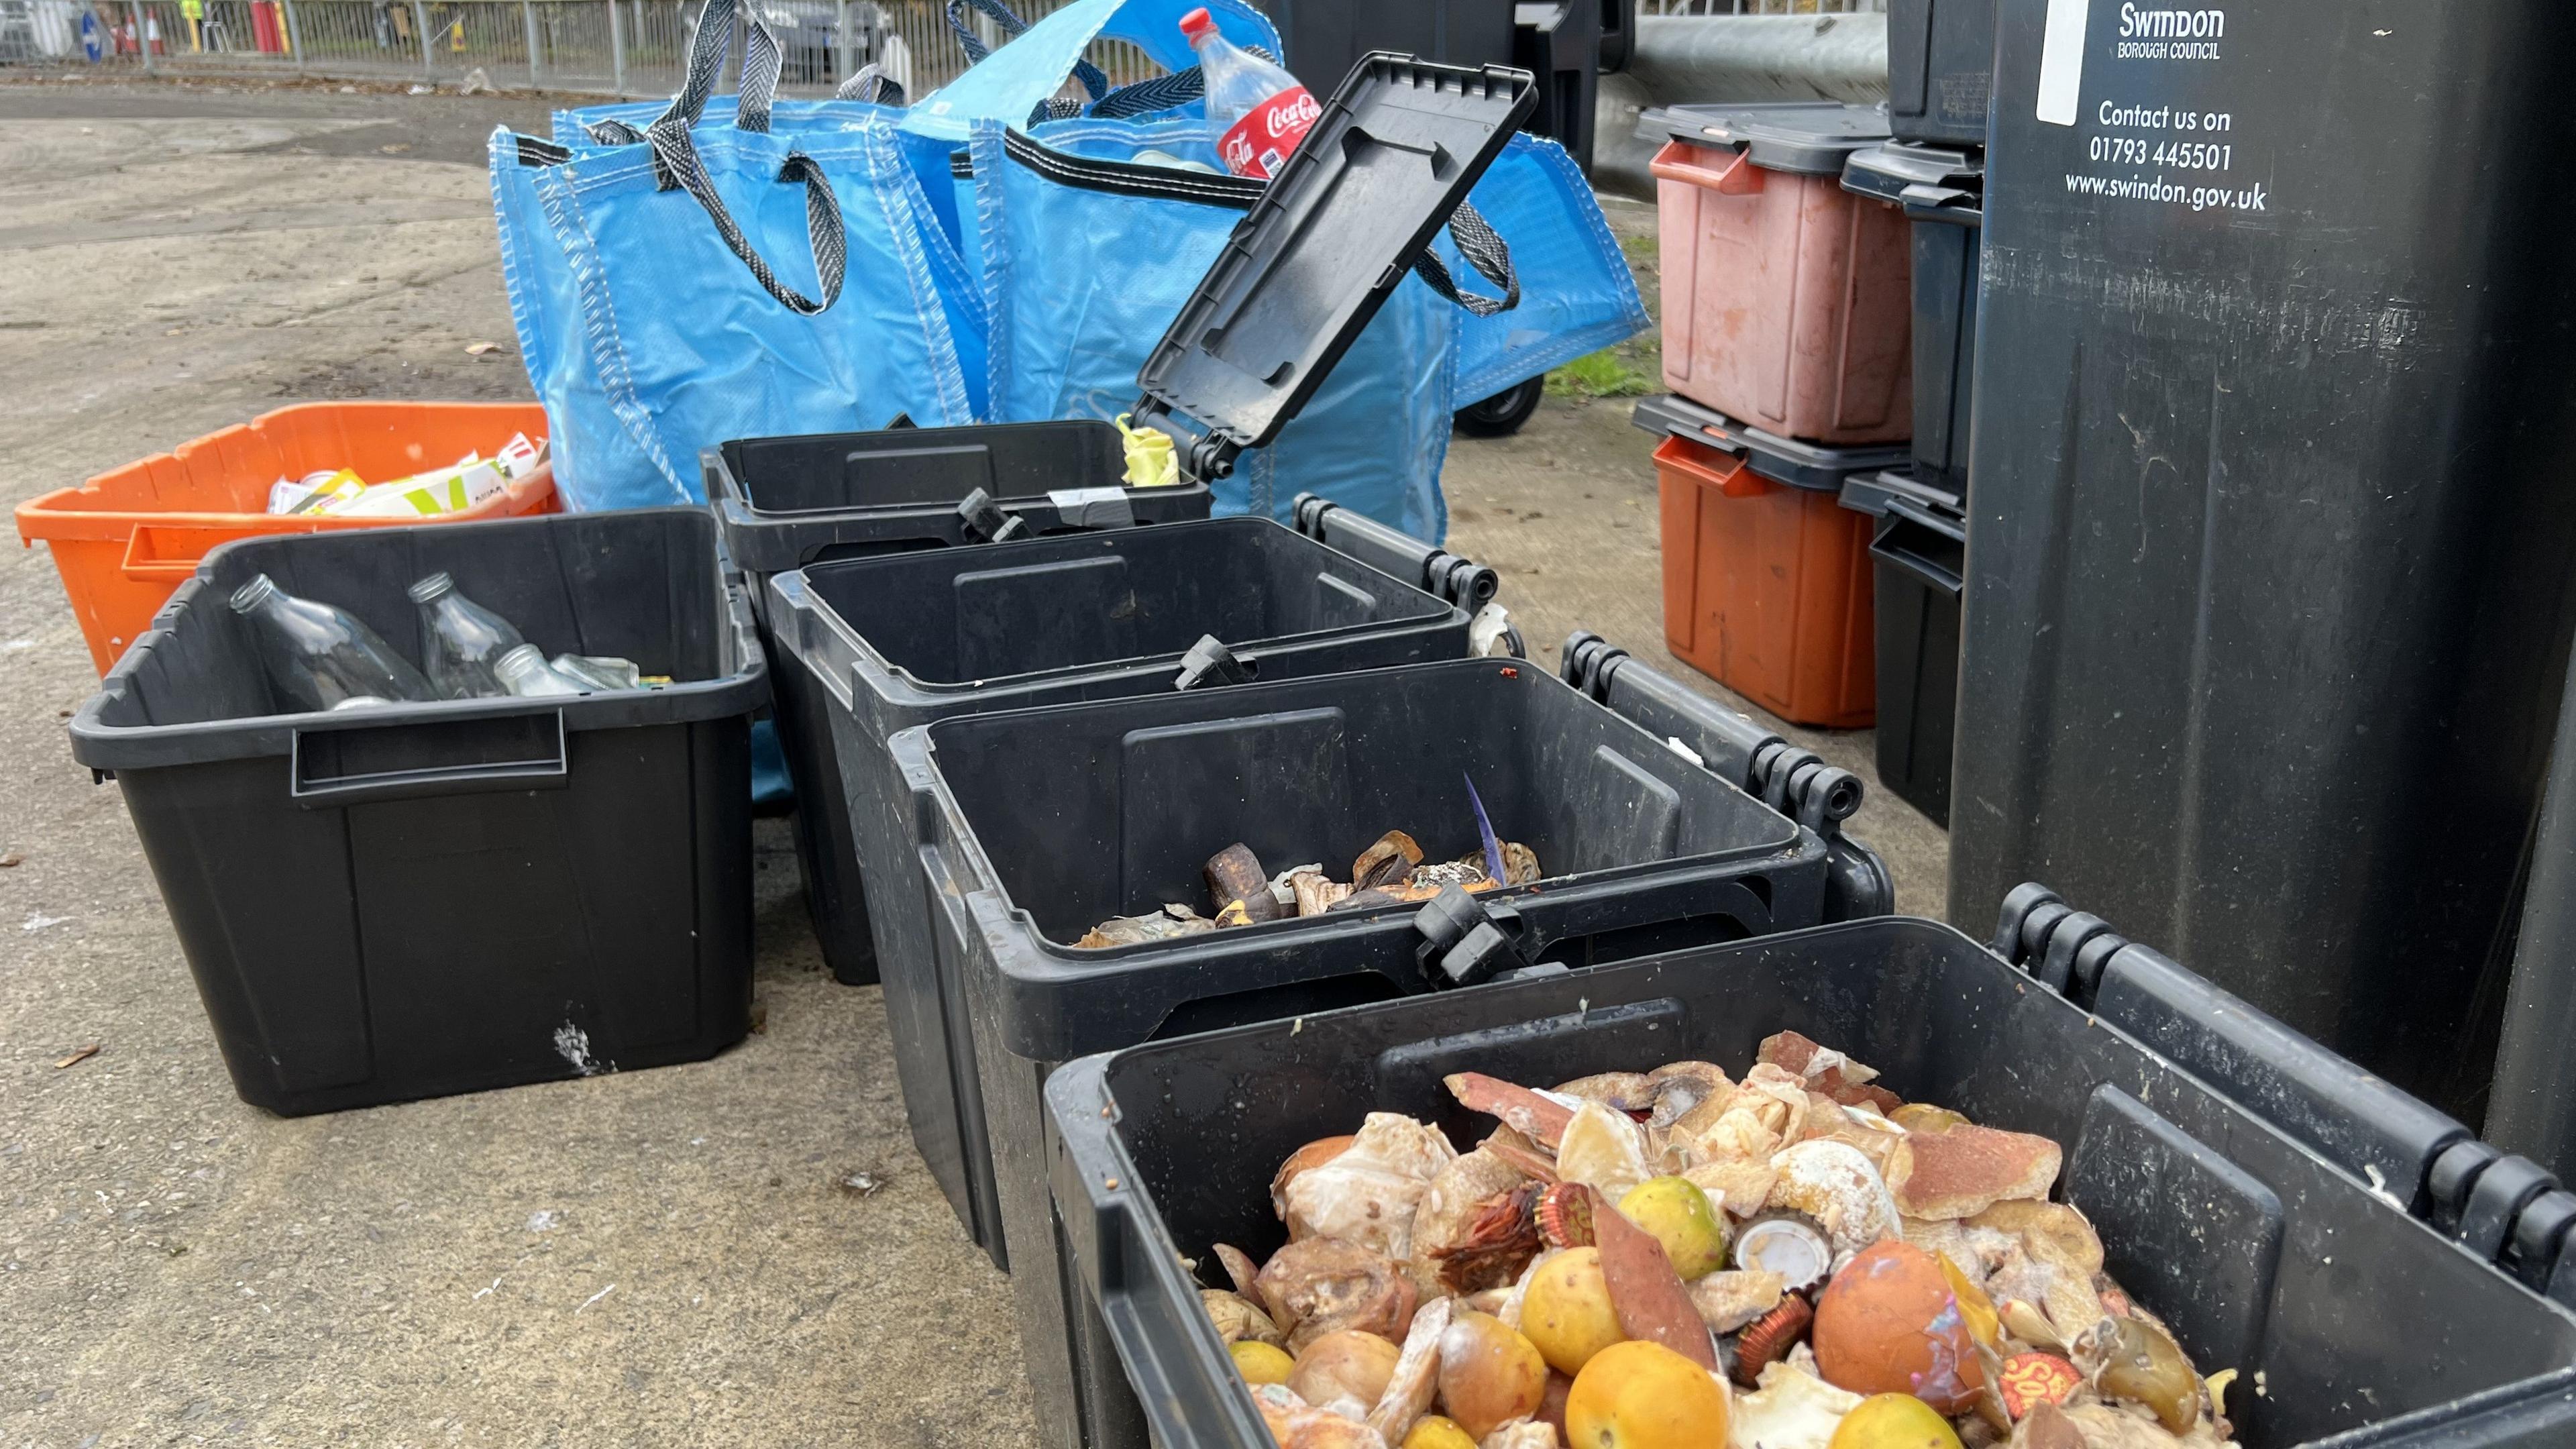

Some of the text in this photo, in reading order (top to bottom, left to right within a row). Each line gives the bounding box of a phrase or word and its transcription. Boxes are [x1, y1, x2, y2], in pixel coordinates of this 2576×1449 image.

[2117, 42, 2220, 60] BOROUGH COUNCIL
[2098, 100, 2231, 131] Contact us on
[2090, 136, 2232, 170] 01793 445501
[2065, 173, 2267, 212] www.swindon.gov.uk
